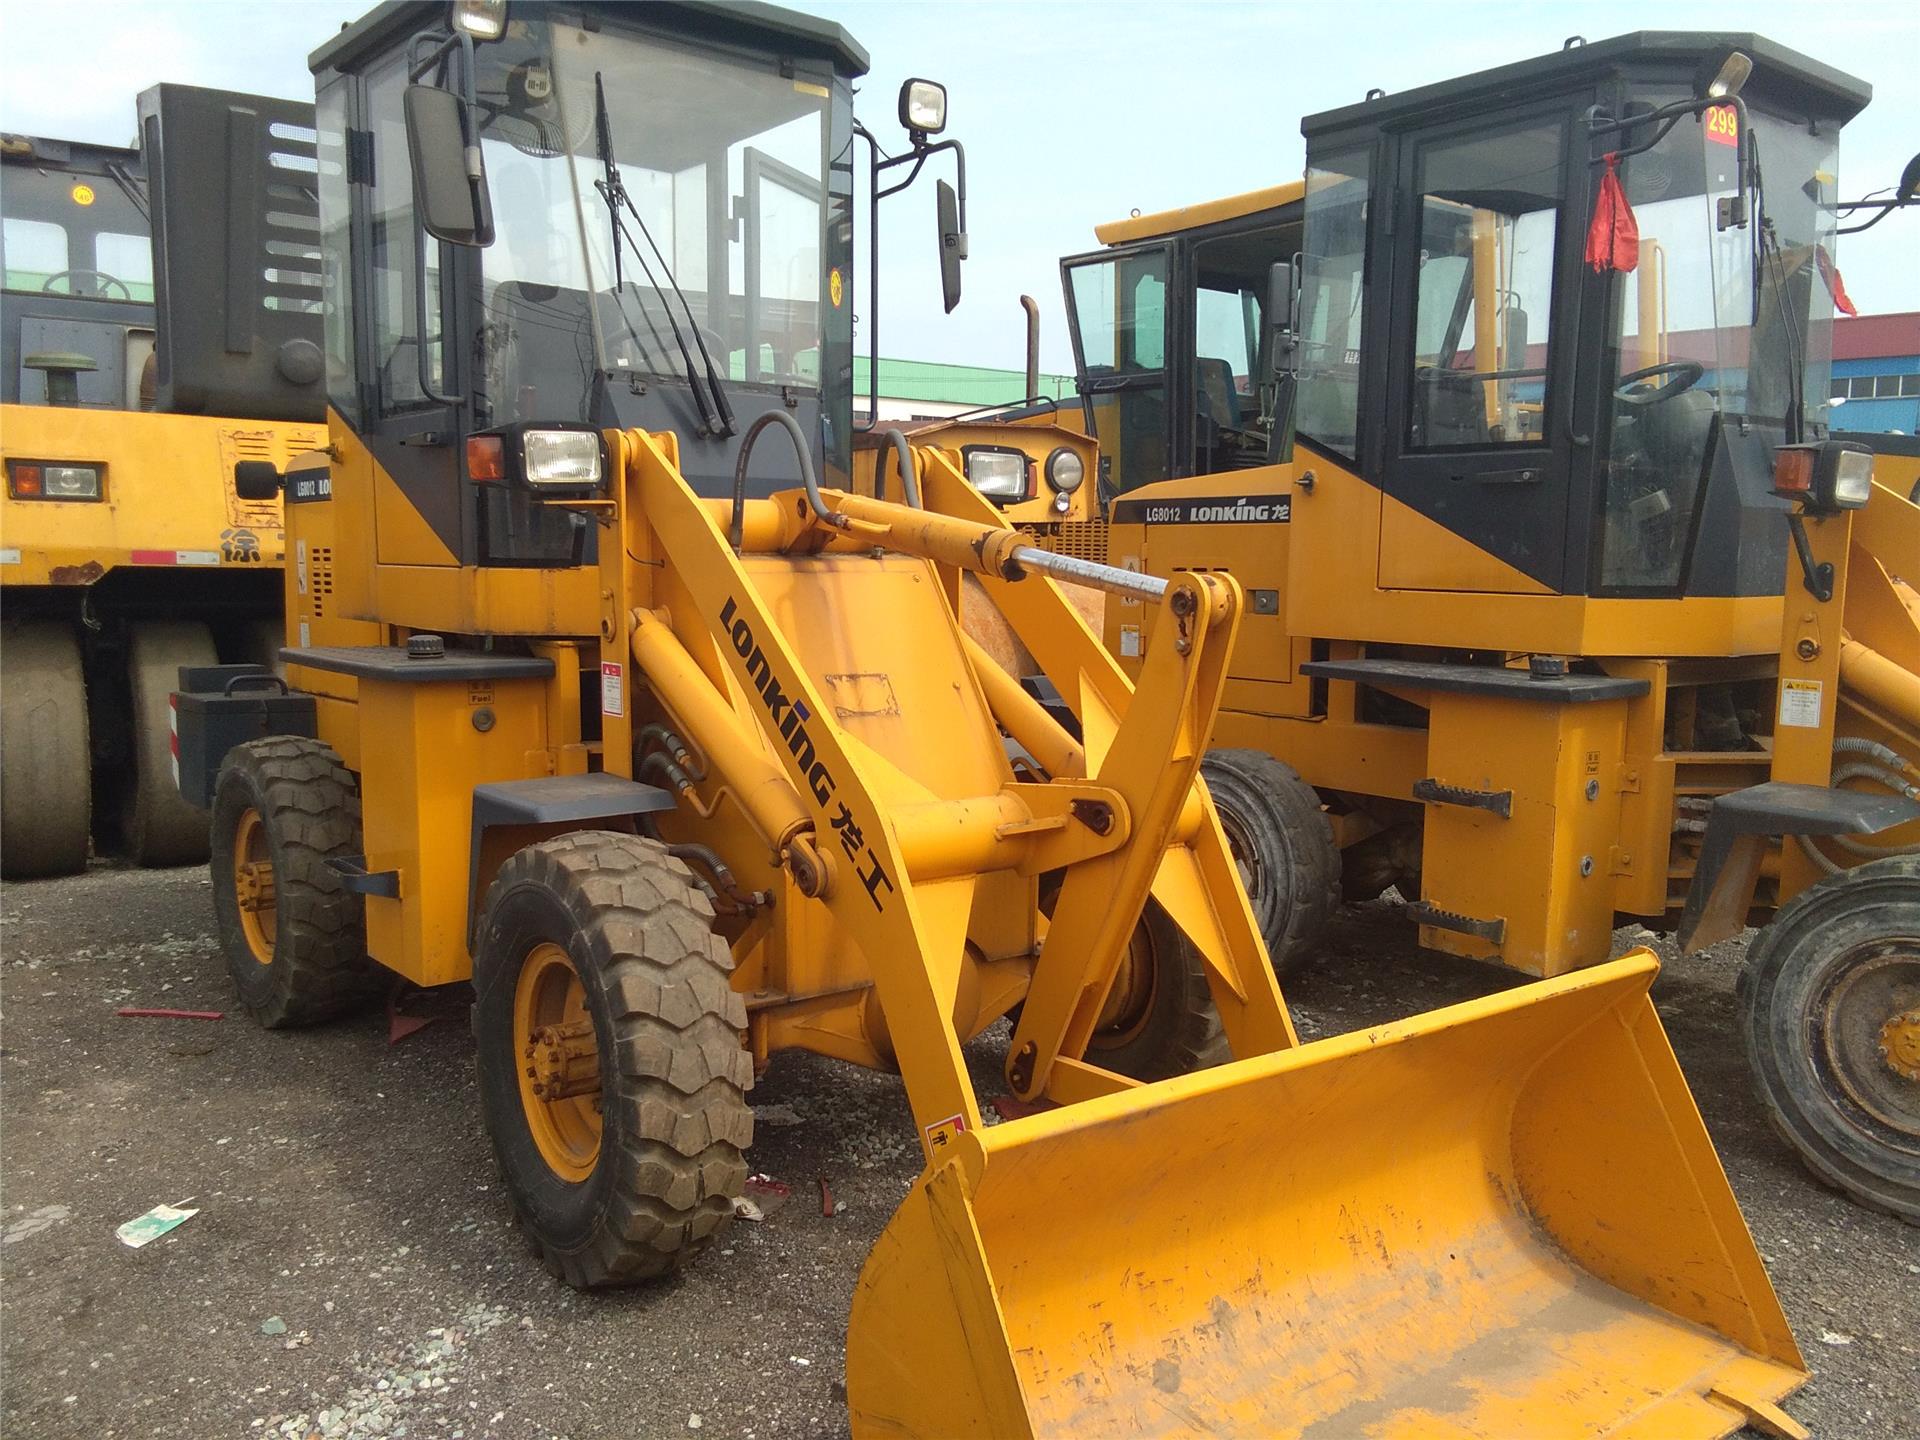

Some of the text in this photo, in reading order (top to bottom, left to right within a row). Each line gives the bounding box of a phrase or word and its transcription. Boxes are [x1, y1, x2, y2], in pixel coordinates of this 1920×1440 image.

[1709, 106, 1737, 137] 299
[1146, 507, 1181, 522] LG8012
[471, 694, 491, 702] Fuel
[830, 800, 894, 914] 龙工
